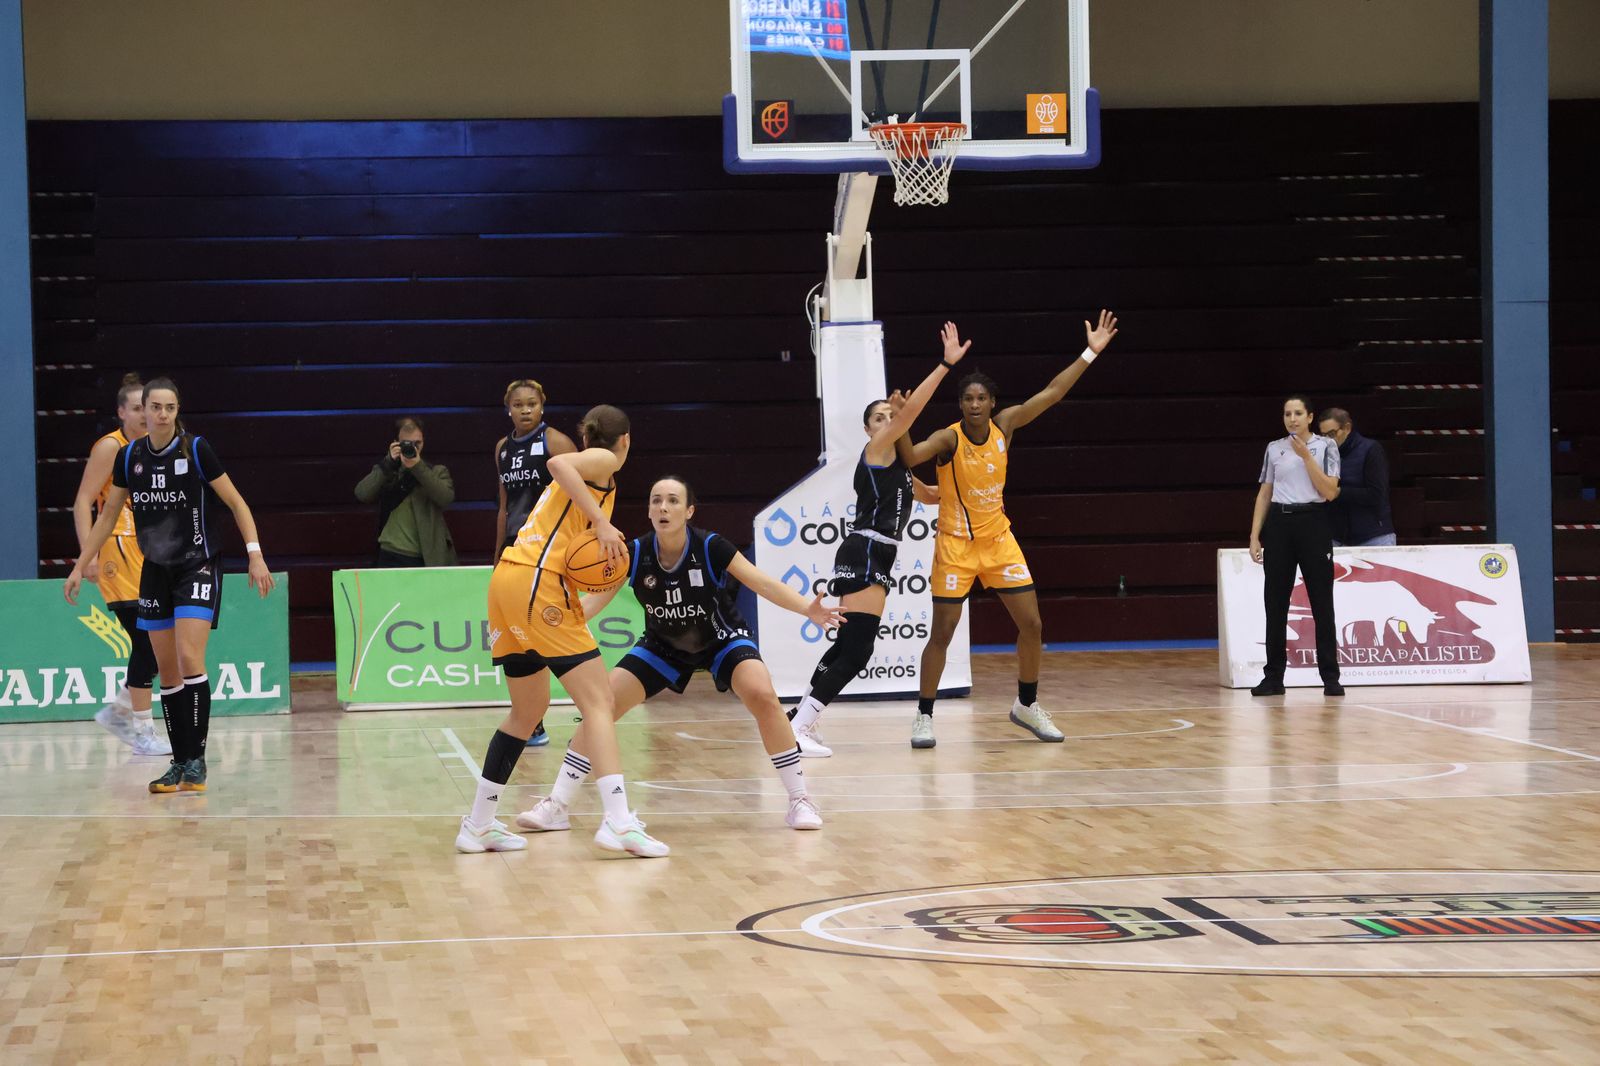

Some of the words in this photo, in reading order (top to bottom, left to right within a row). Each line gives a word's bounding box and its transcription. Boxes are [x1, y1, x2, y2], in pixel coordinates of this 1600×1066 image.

[511, 456, 524, 469] 15
[151, 474, 166, 489] 18
[132, 489, 187, 503] DOMUSA
[191, 582, 212, 601] 18
[665, 588, 683, 605] 10
[646, 604, 706, 619] DOMUSA
[1411, 645, 1482, 662] ALISTE
[386, 663, 501, 688] CASH
[1420, 667, 1468, 676] PROTEGIDA
[0, 667, 97, 708] AJA
